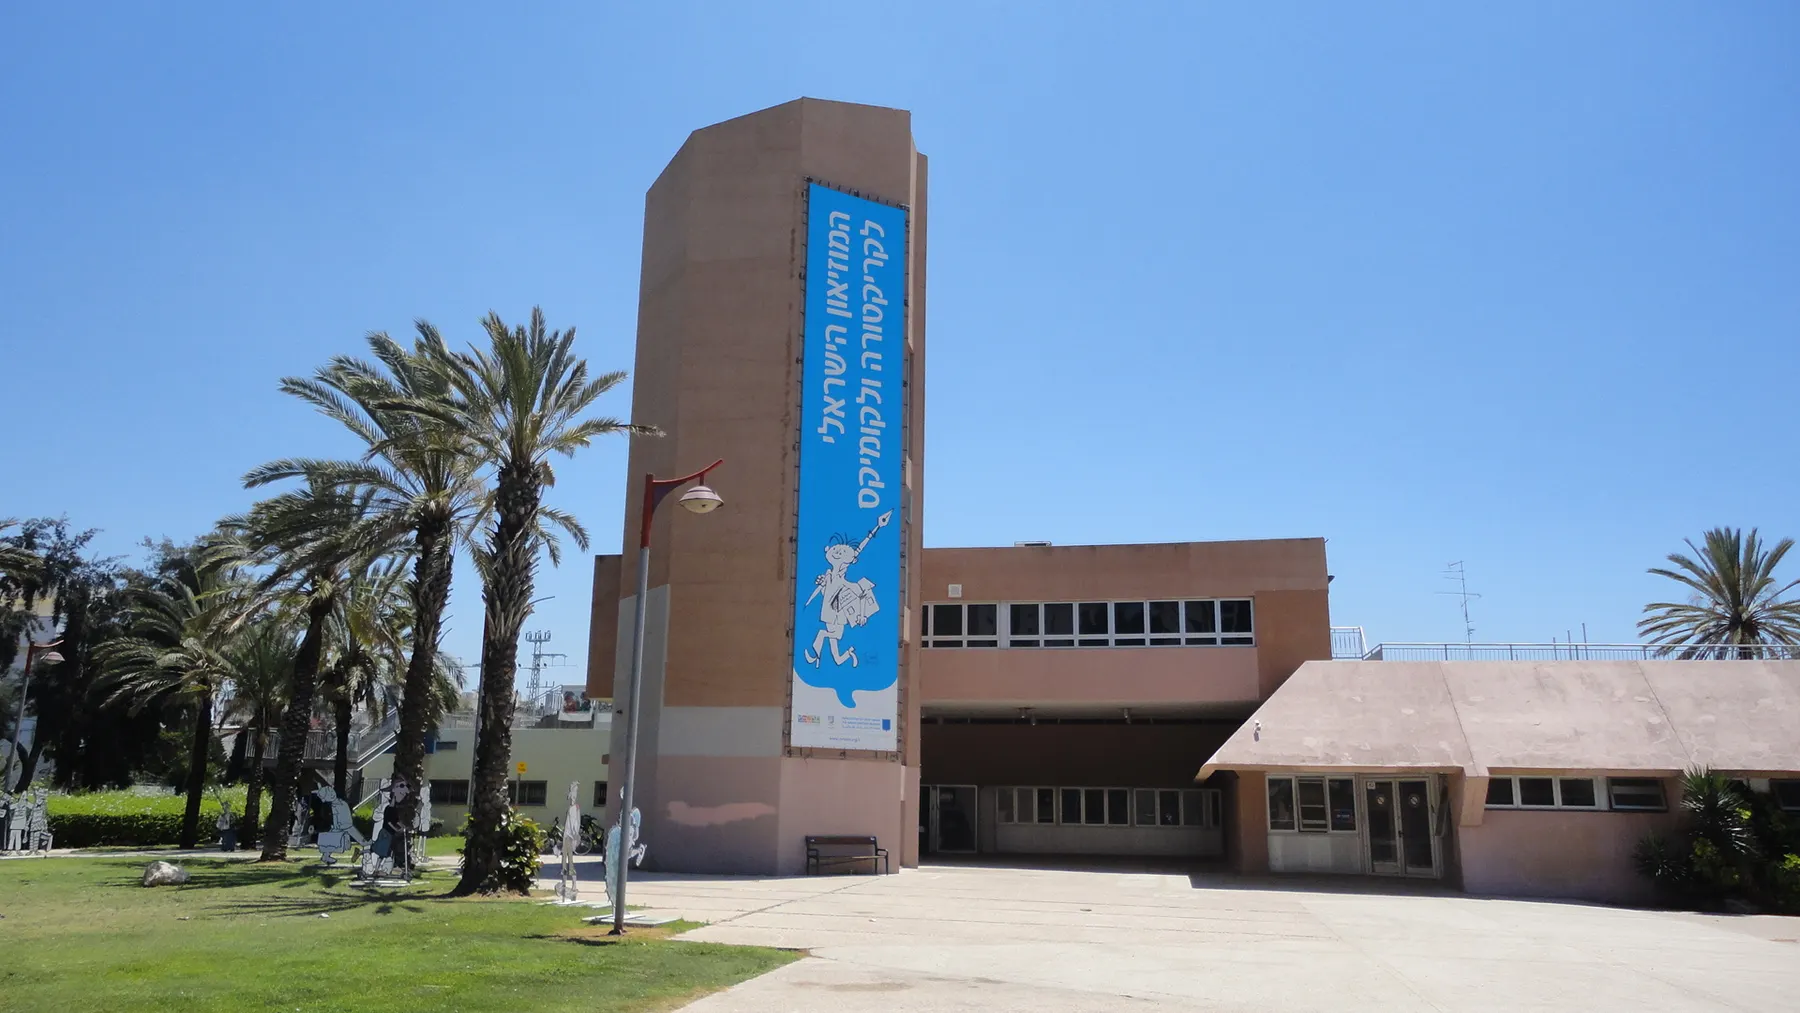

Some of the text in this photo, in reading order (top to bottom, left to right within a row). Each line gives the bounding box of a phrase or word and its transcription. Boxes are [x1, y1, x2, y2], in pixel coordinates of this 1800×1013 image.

[818, 211, 852, 444] המוזיאון הישראלי
[856, 219, 889, 509] לקריקטורה ולקומיקס
